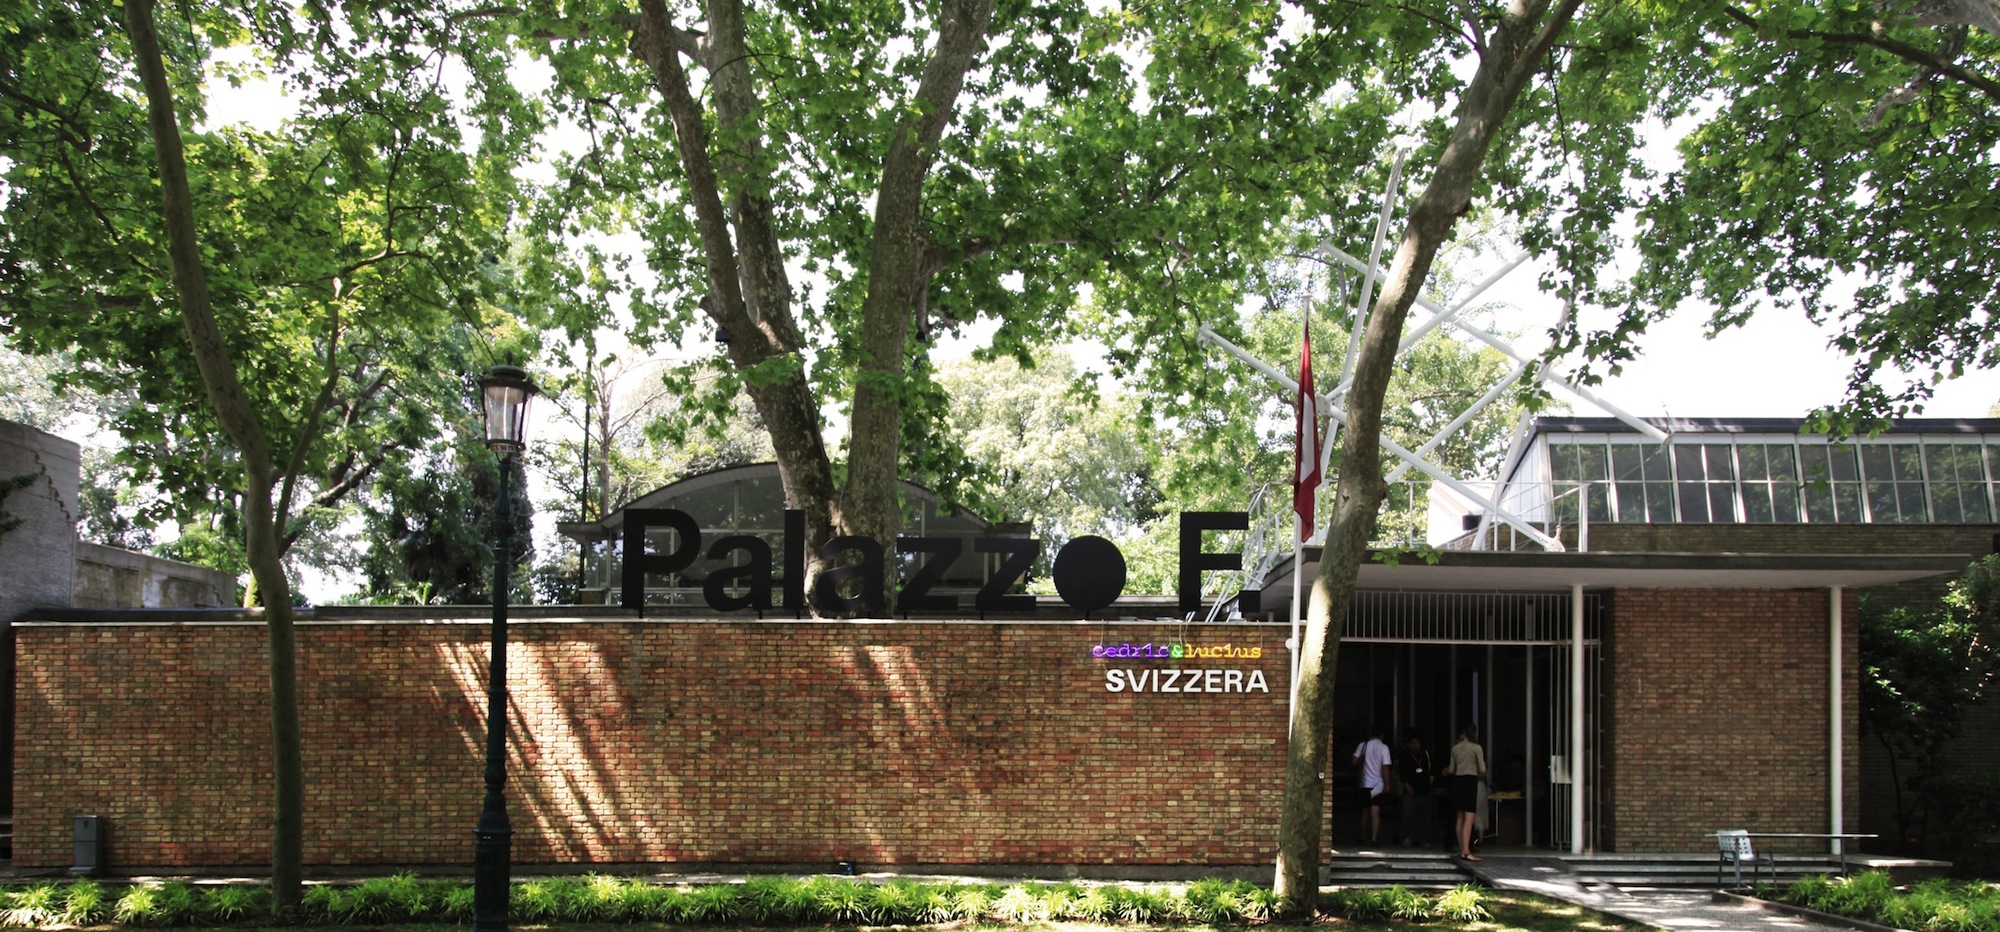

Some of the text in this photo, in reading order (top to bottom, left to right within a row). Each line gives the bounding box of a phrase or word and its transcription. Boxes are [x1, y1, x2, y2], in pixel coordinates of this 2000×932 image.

[621, 508, 1260, 612] Palazzo F.
[1105, 669, 1270, 693] SVIZZERA
